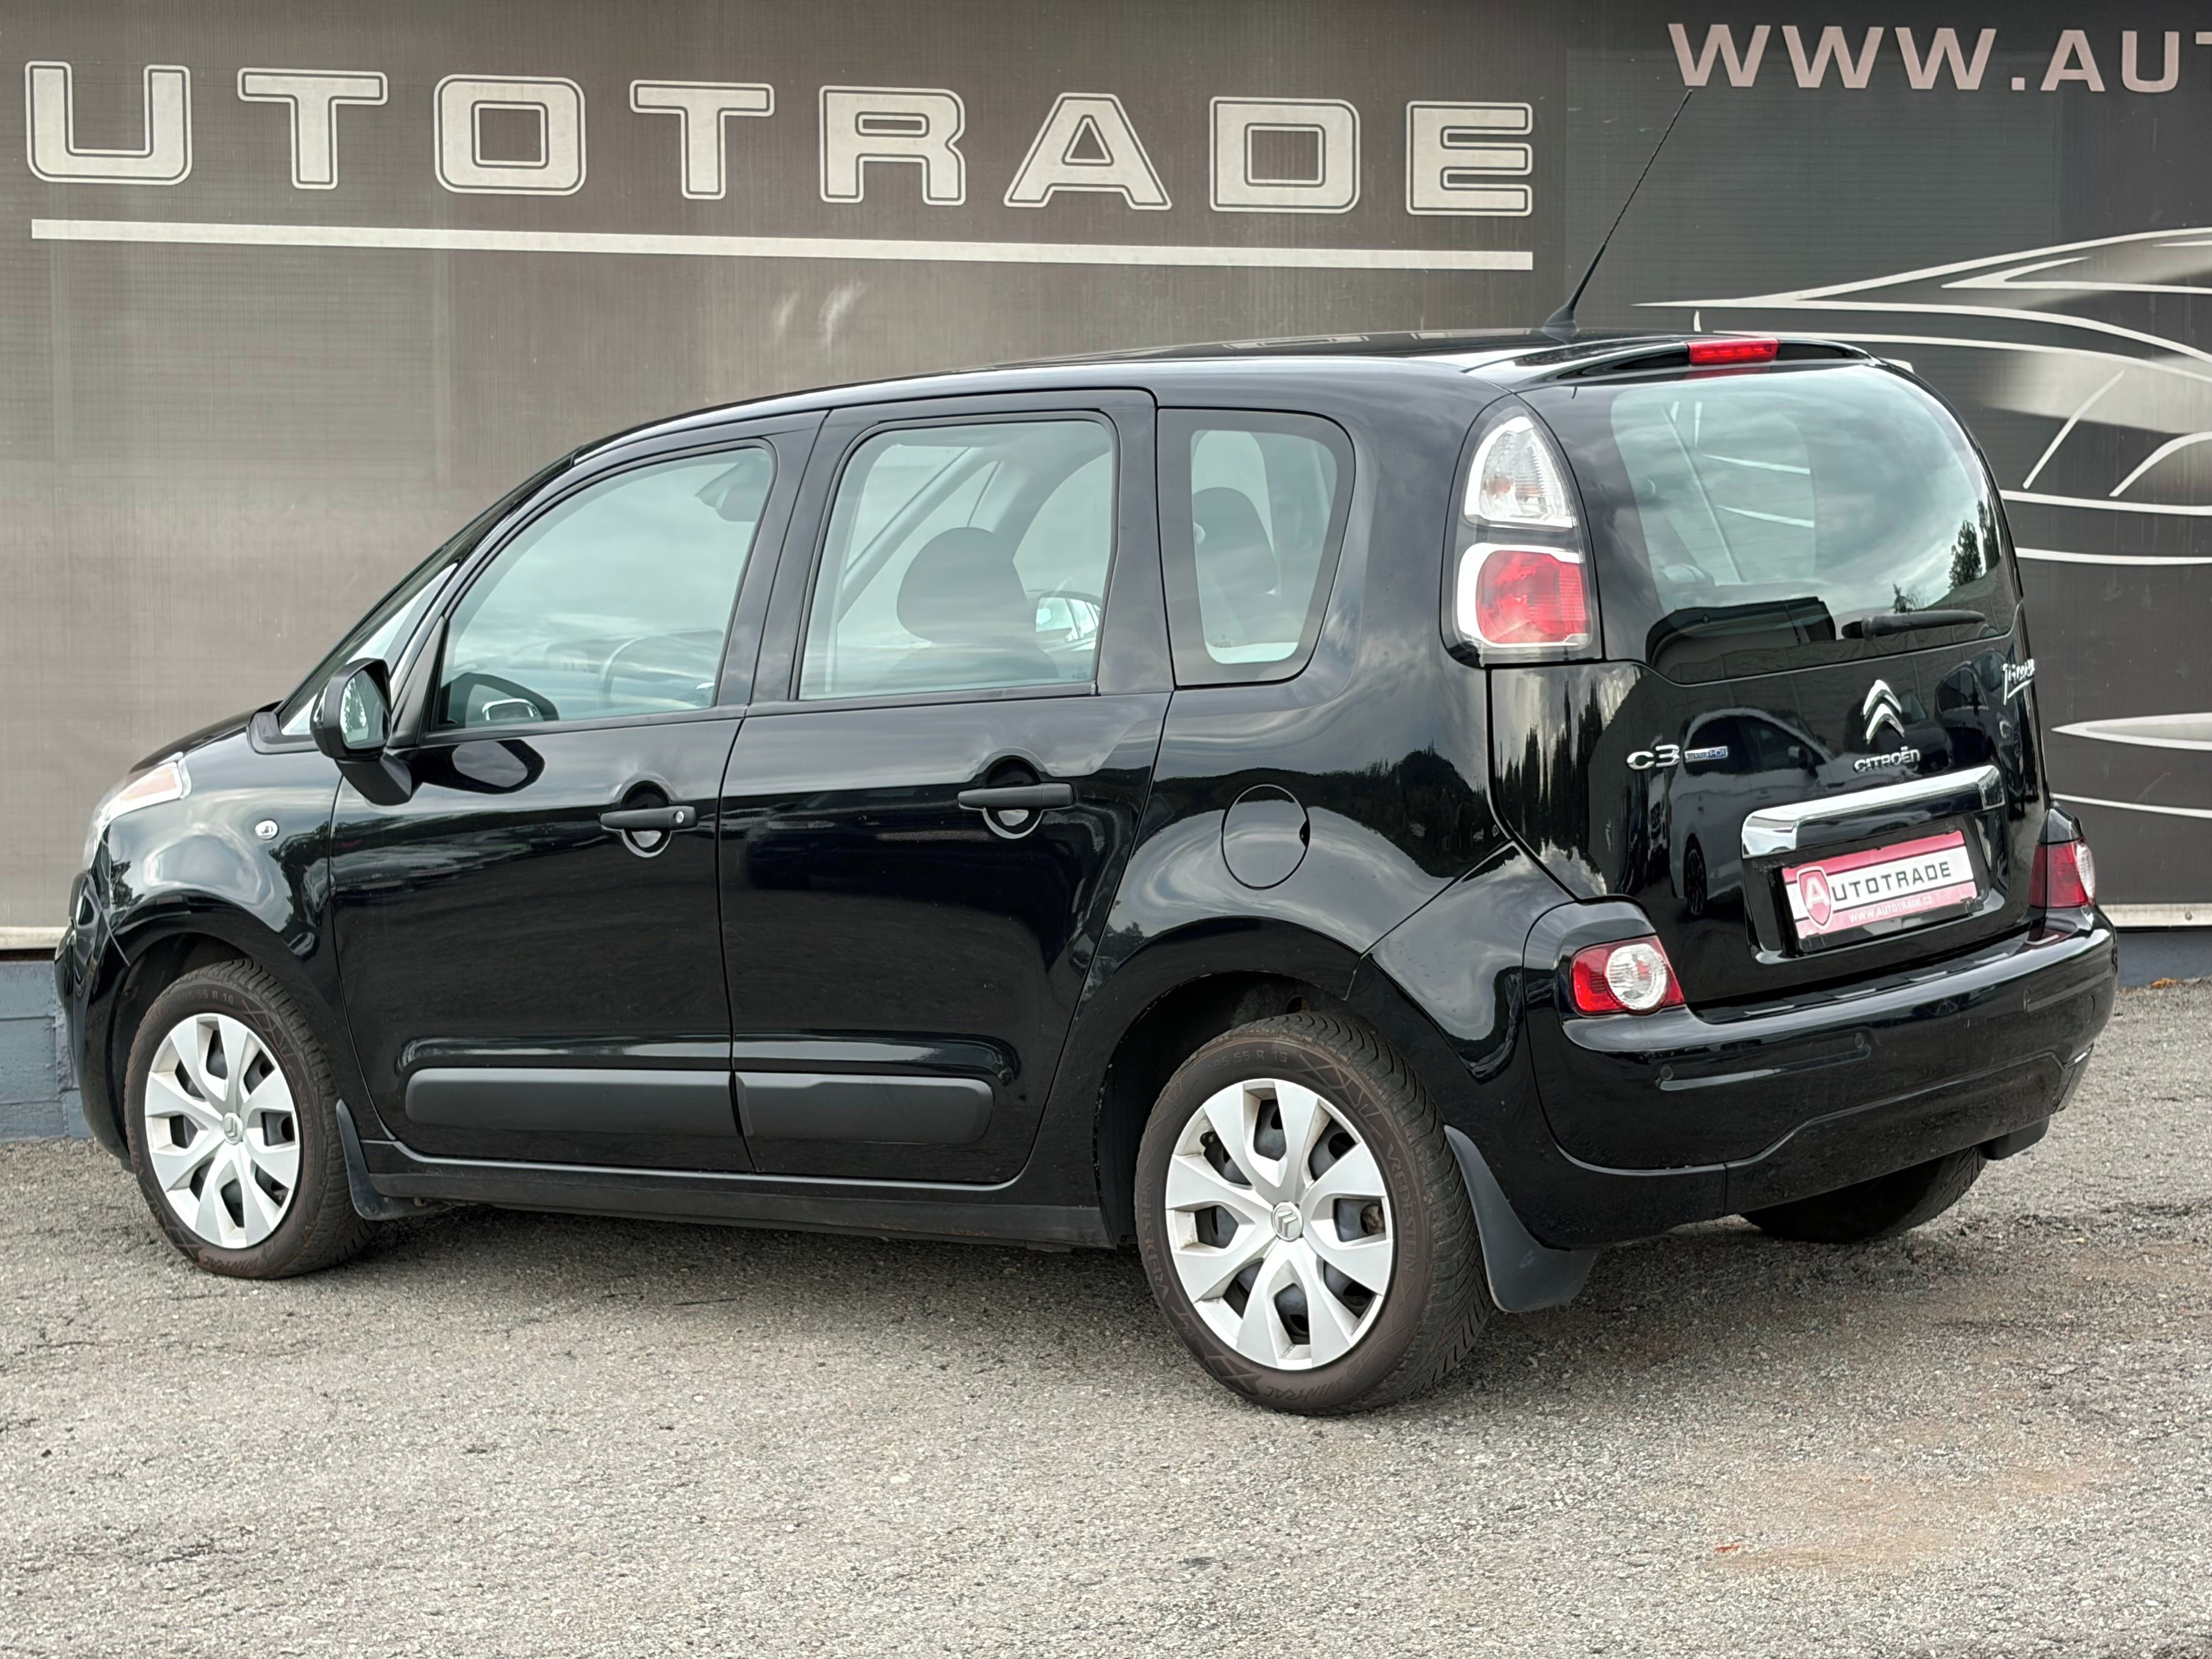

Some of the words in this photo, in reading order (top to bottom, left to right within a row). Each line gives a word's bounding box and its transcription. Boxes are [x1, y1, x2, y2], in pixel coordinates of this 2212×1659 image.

[1668, 23, 2212, 93] WWW.AU
[25, 60, 1533, 216] UTOTRADE
[1627, 744, 1680, 770] C3
[1854, 746, 1920, 772] CITROËN
[1848, 895, 1933, 923] WWW.AUTOTRADE.CZ
[1387, 1143, 1417, 1272] VREDESTEIN
